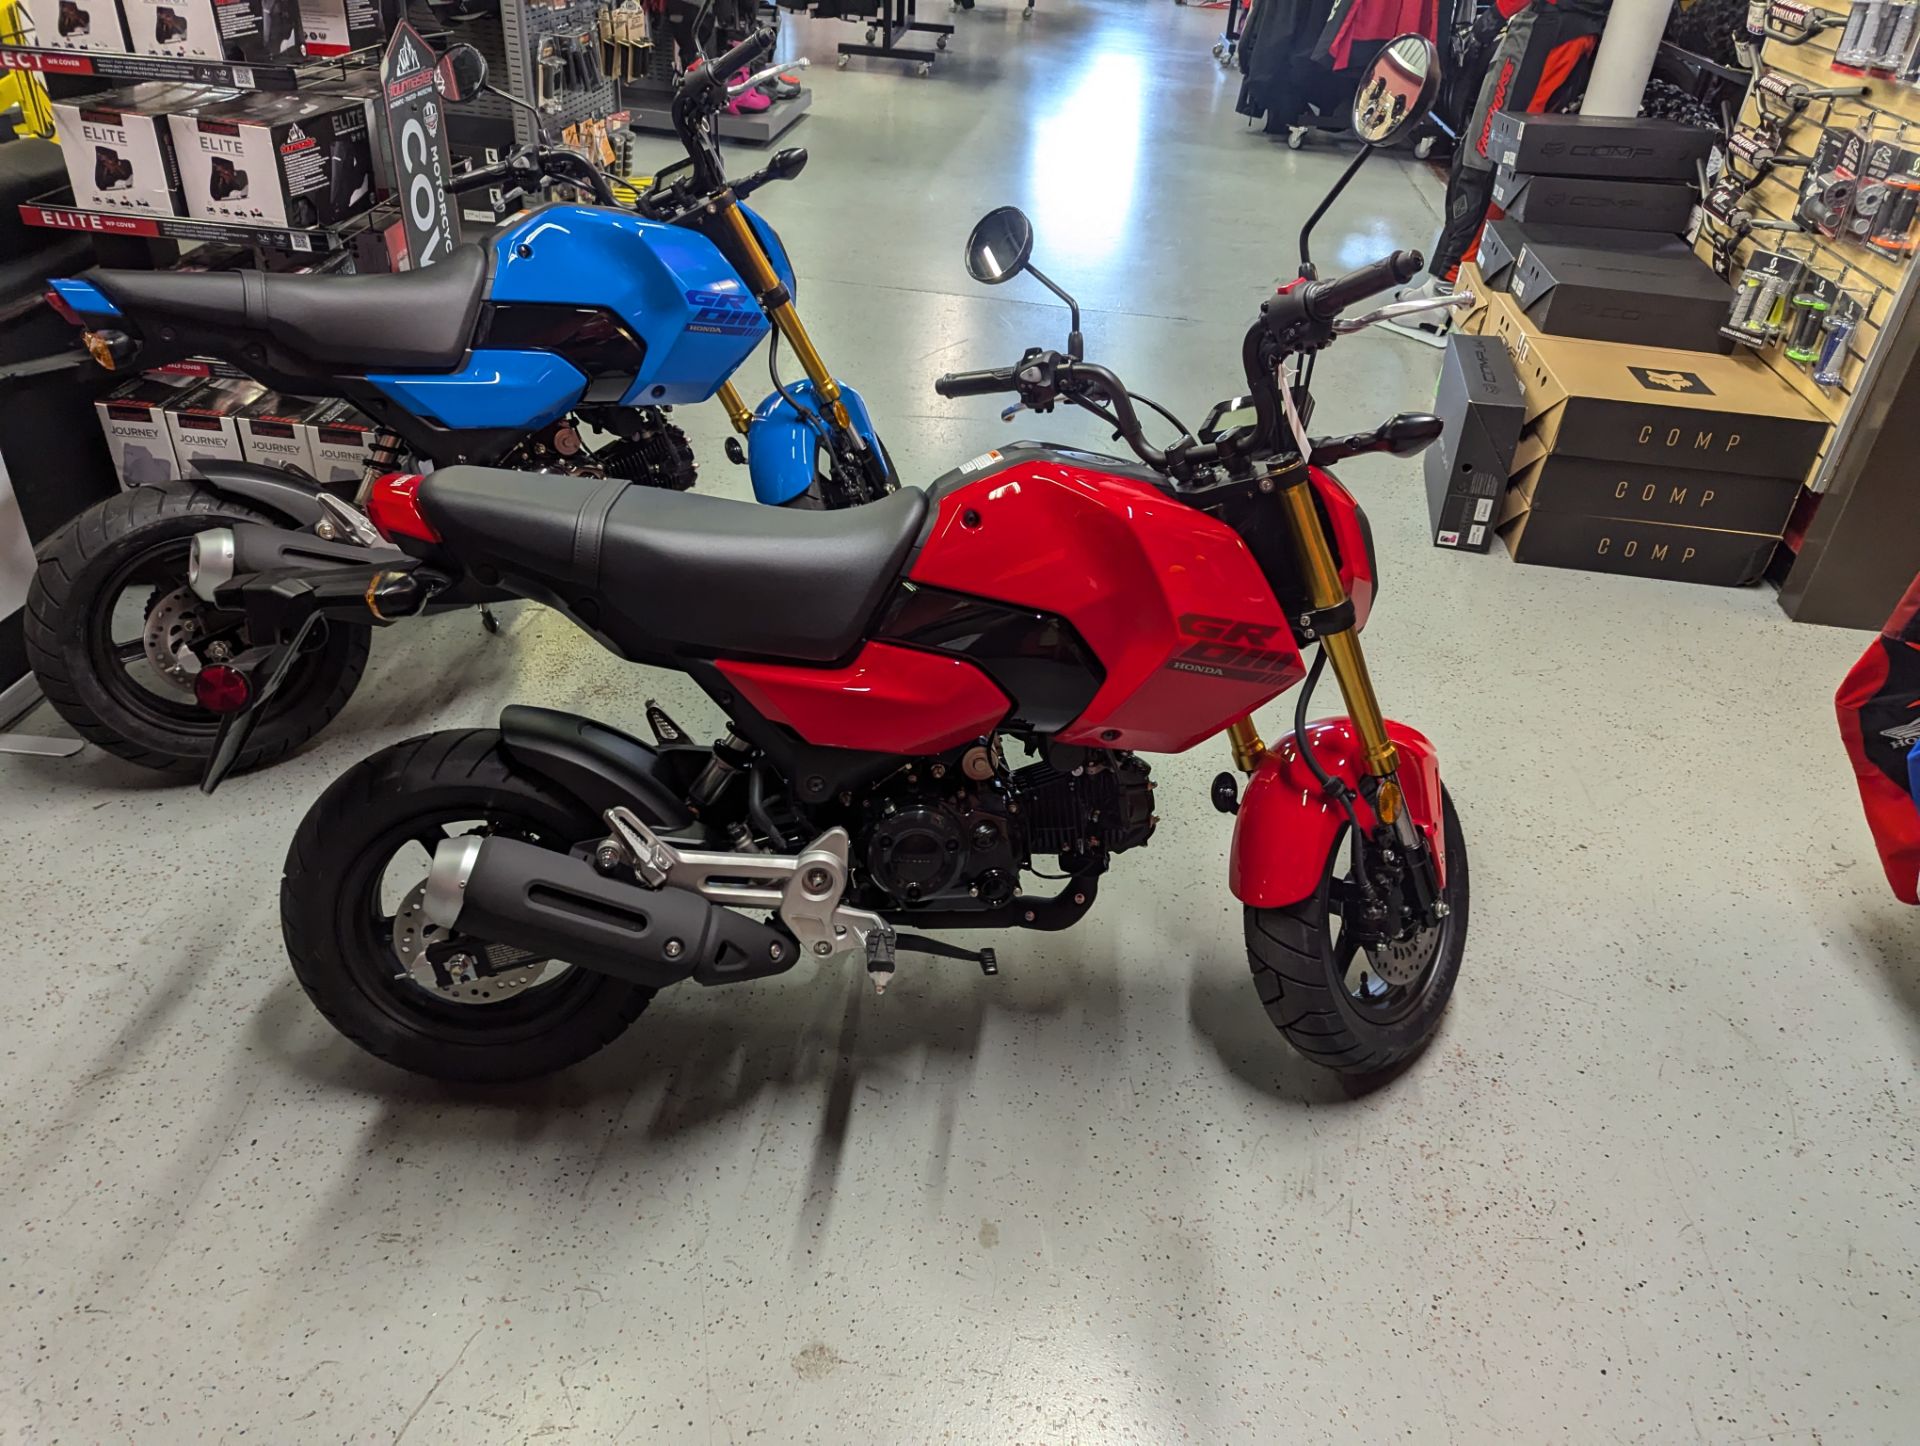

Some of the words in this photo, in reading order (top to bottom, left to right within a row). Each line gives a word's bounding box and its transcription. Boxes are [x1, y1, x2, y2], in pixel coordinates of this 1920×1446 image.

[0, 53, 43, 69] ECT
[58, 59, 80, 67] COVER
[1760, 76, 1787, 96] RENTHAL
[331, 109, 364, 131] ELITE
[83, 126, 128, 144] ELITE
[200, 137, 244, 154] ELITE
[1569, 144, 1655, 159] COMP
[41, 211, 104, 229] ELITE
[116, 221, 136, 229] COVER
[688, 324, 722, 334] HONDA
[111, 425, 159, 438] JOURNEY
[1638, 425, 1741, 452] COMP
[180, 434, 228, 447] JOURNEY
[252, 441, 301, 454] JOURNEY
[319, 449, 368, 461] JOURNEY
[1615, 481, 1715, 507] COMP
[1597, 538, 1696, 563] COMP
[1172, 661, 1224, 676] HONDA
